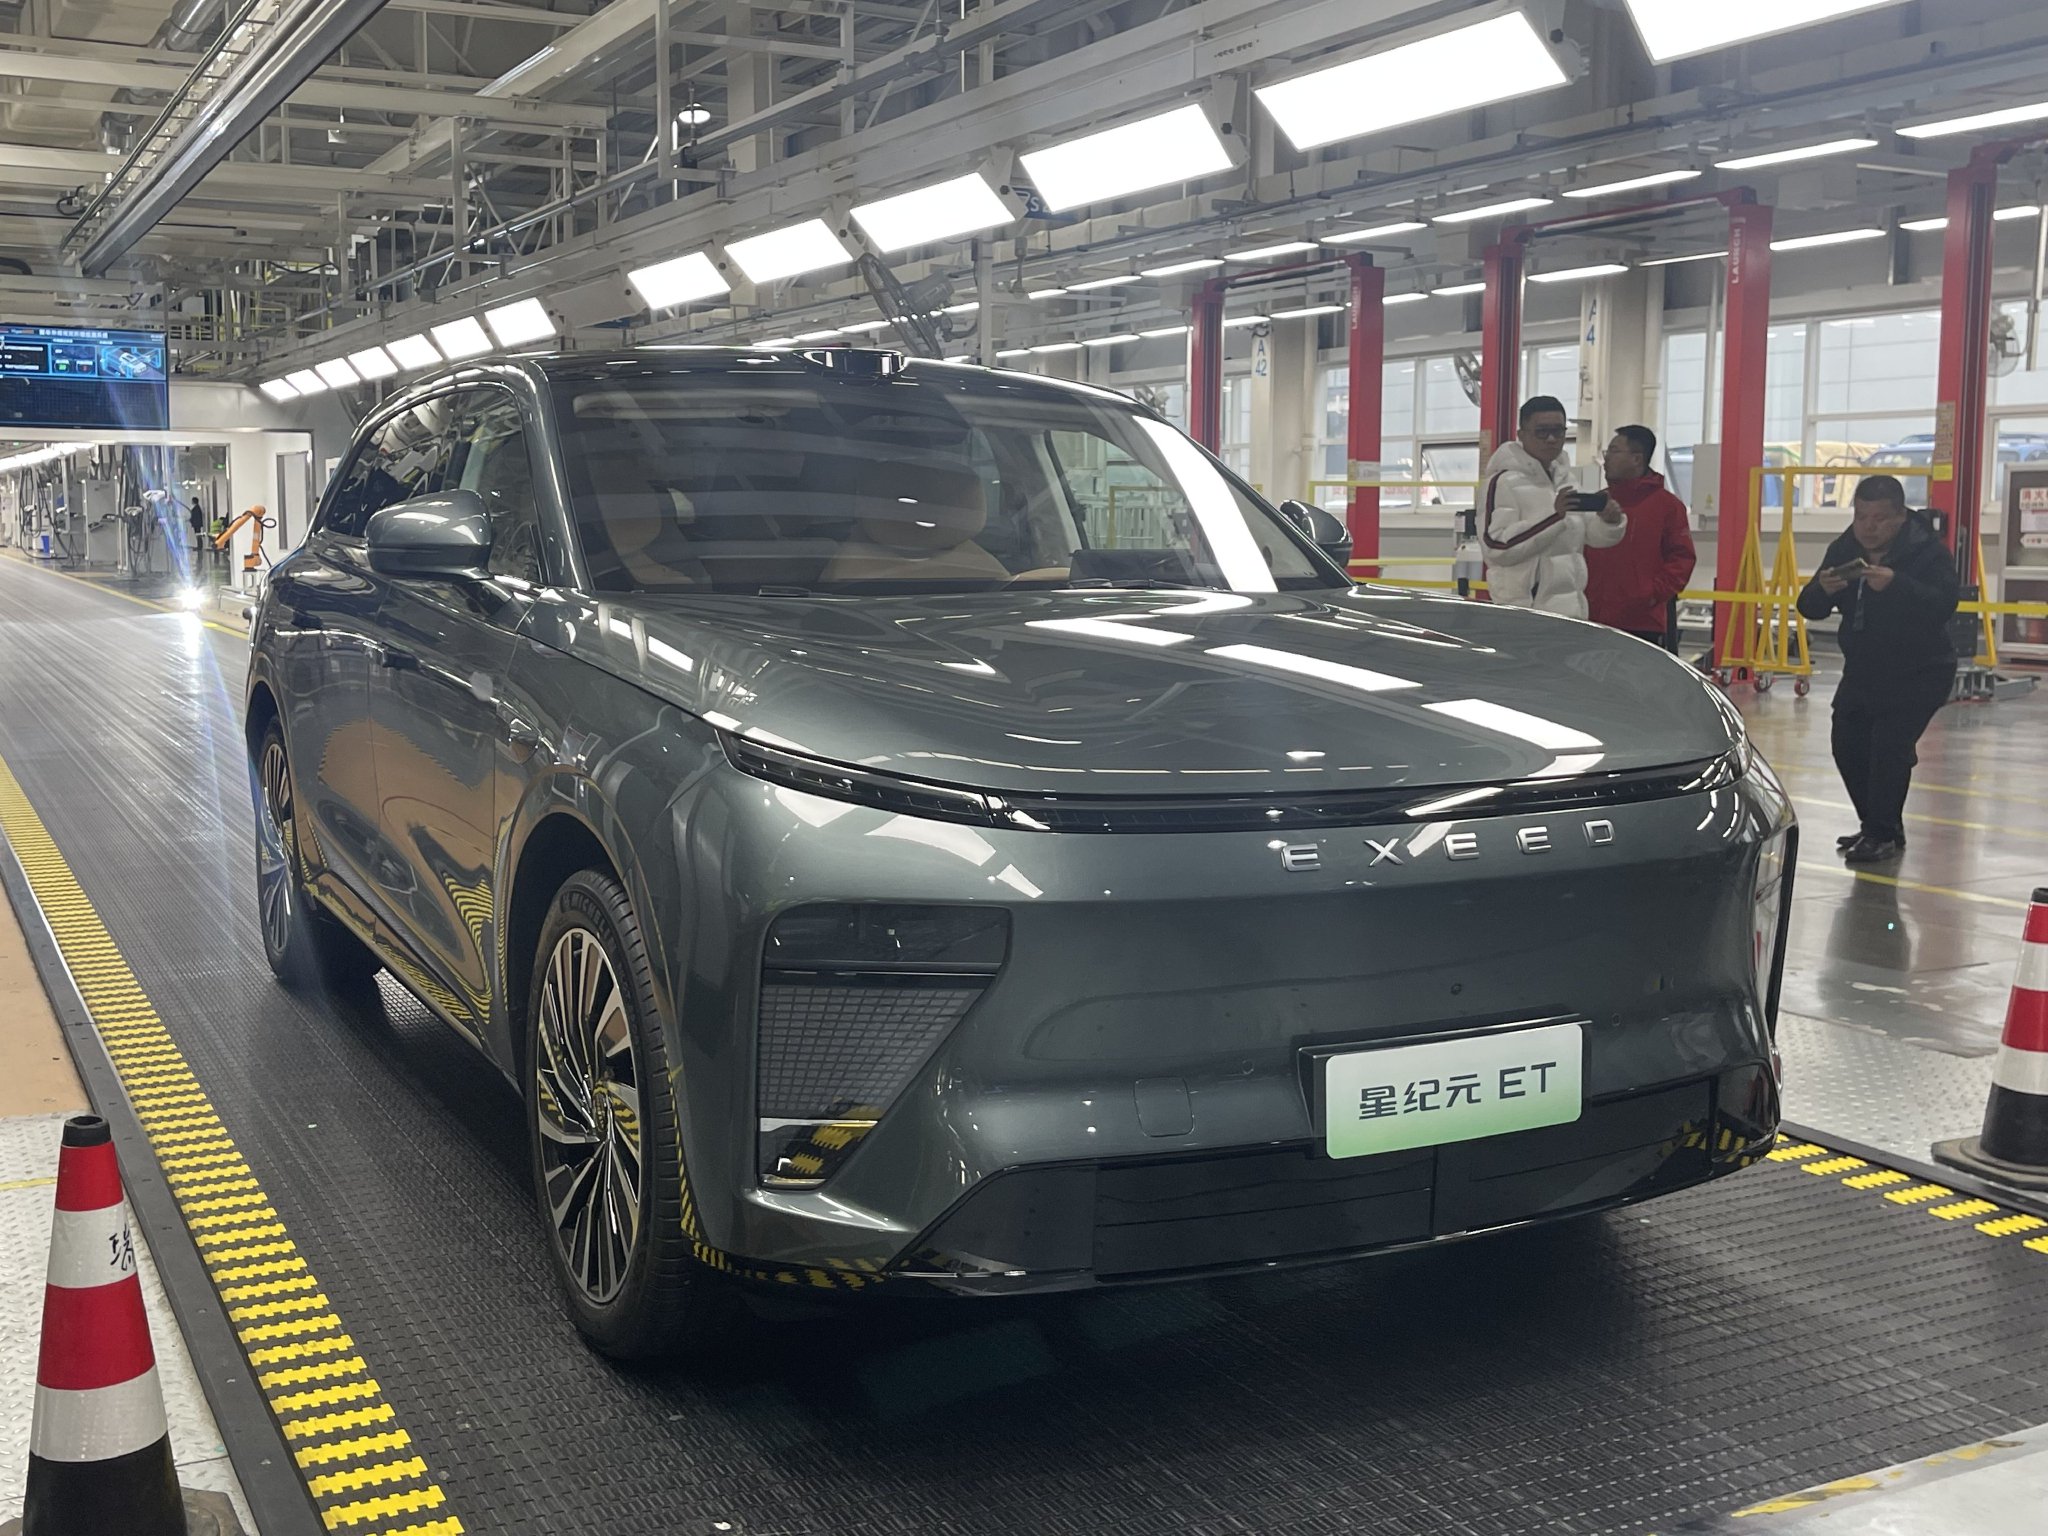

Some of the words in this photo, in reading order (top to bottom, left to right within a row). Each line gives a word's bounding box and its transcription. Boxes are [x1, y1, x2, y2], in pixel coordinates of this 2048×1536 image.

[1731, 228, 1742, 284] LAUNCH
[1257, 339, 1266, 357] A
[1255, 359, 1267, 377] 42
[2022, 489, 2048, 501] 消火
[1281, 818, 1616, 873] EXEED
[1358, 1073, 1482, 1121] 星纪元
[1499, 1061, 1557, 1099] ET
